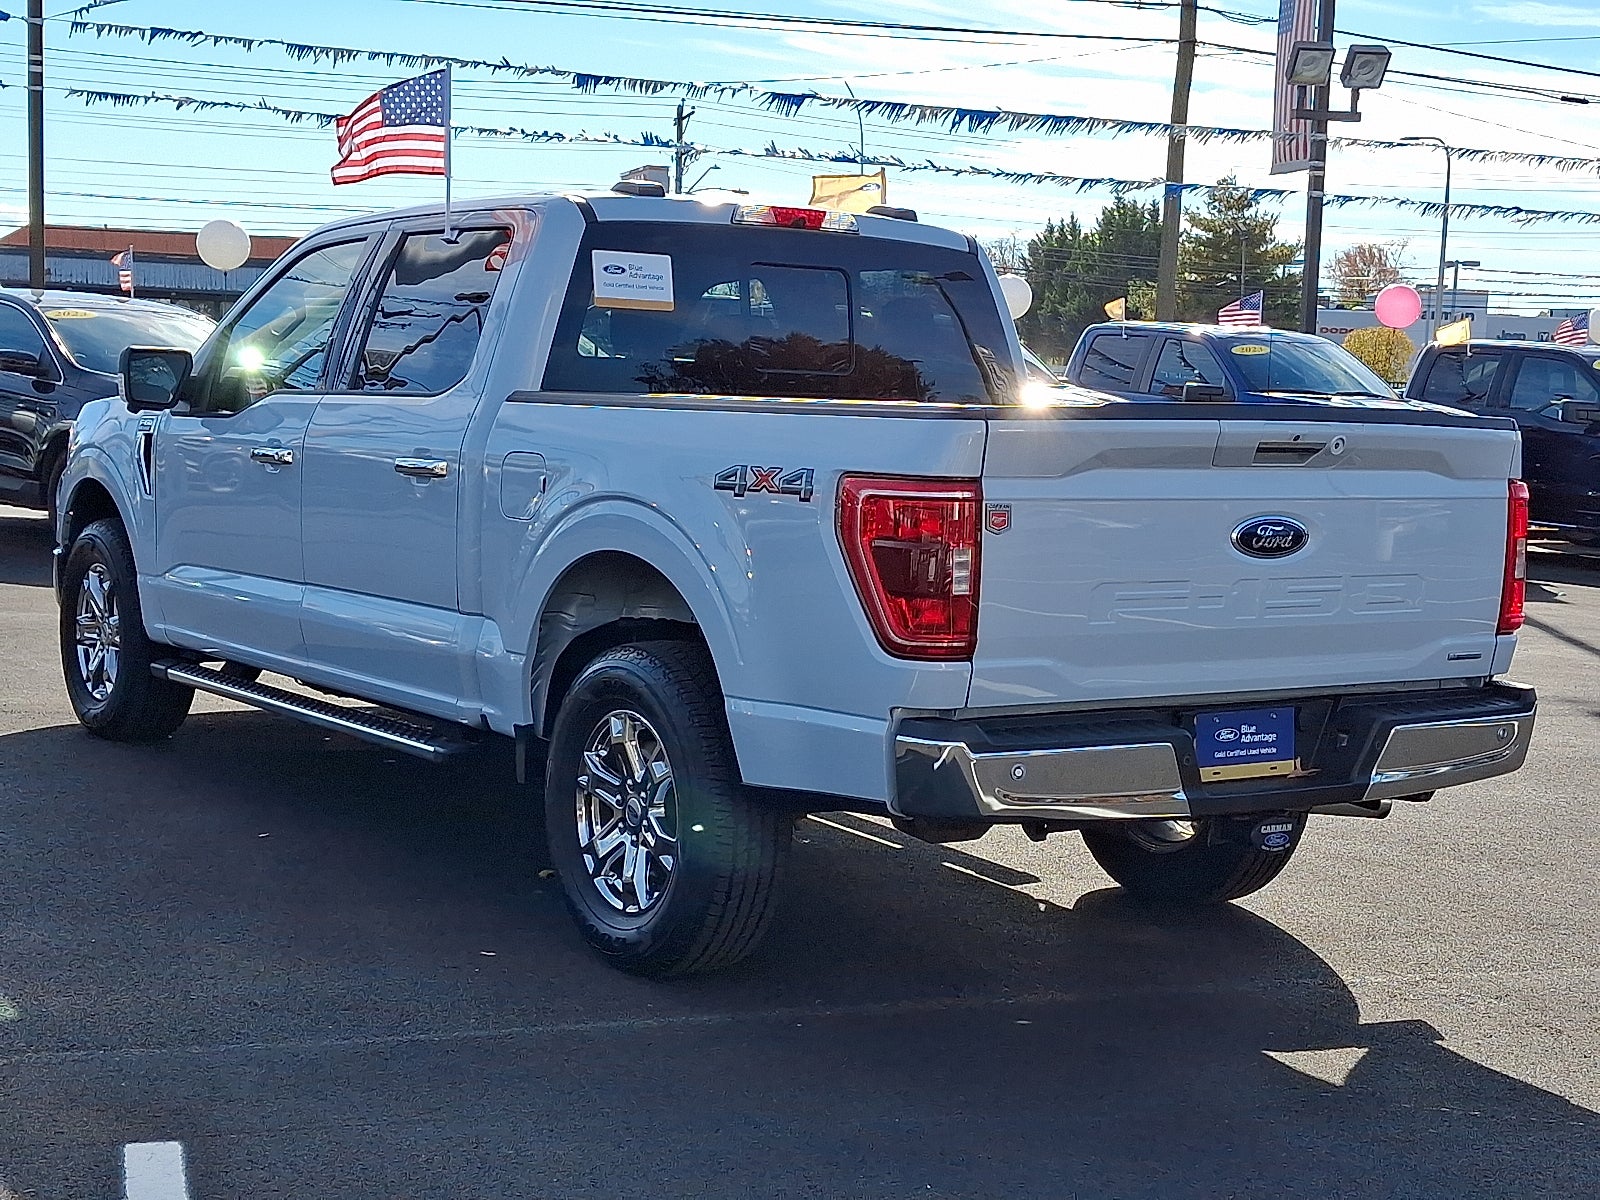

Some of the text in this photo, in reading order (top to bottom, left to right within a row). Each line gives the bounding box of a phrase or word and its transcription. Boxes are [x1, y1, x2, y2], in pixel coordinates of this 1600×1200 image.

[628, 264, 643, 272] Blue
[628, 271, 664, 281] Advantage
[1241, 725, 1256, 733] Blue
[1241, 733, 1277, 743] Advantage
[1214, 750, 1226, 758] Gold
[1226, 749, 1246, 757] Certified
[1261, 824, 1293, 834] CARMAN
